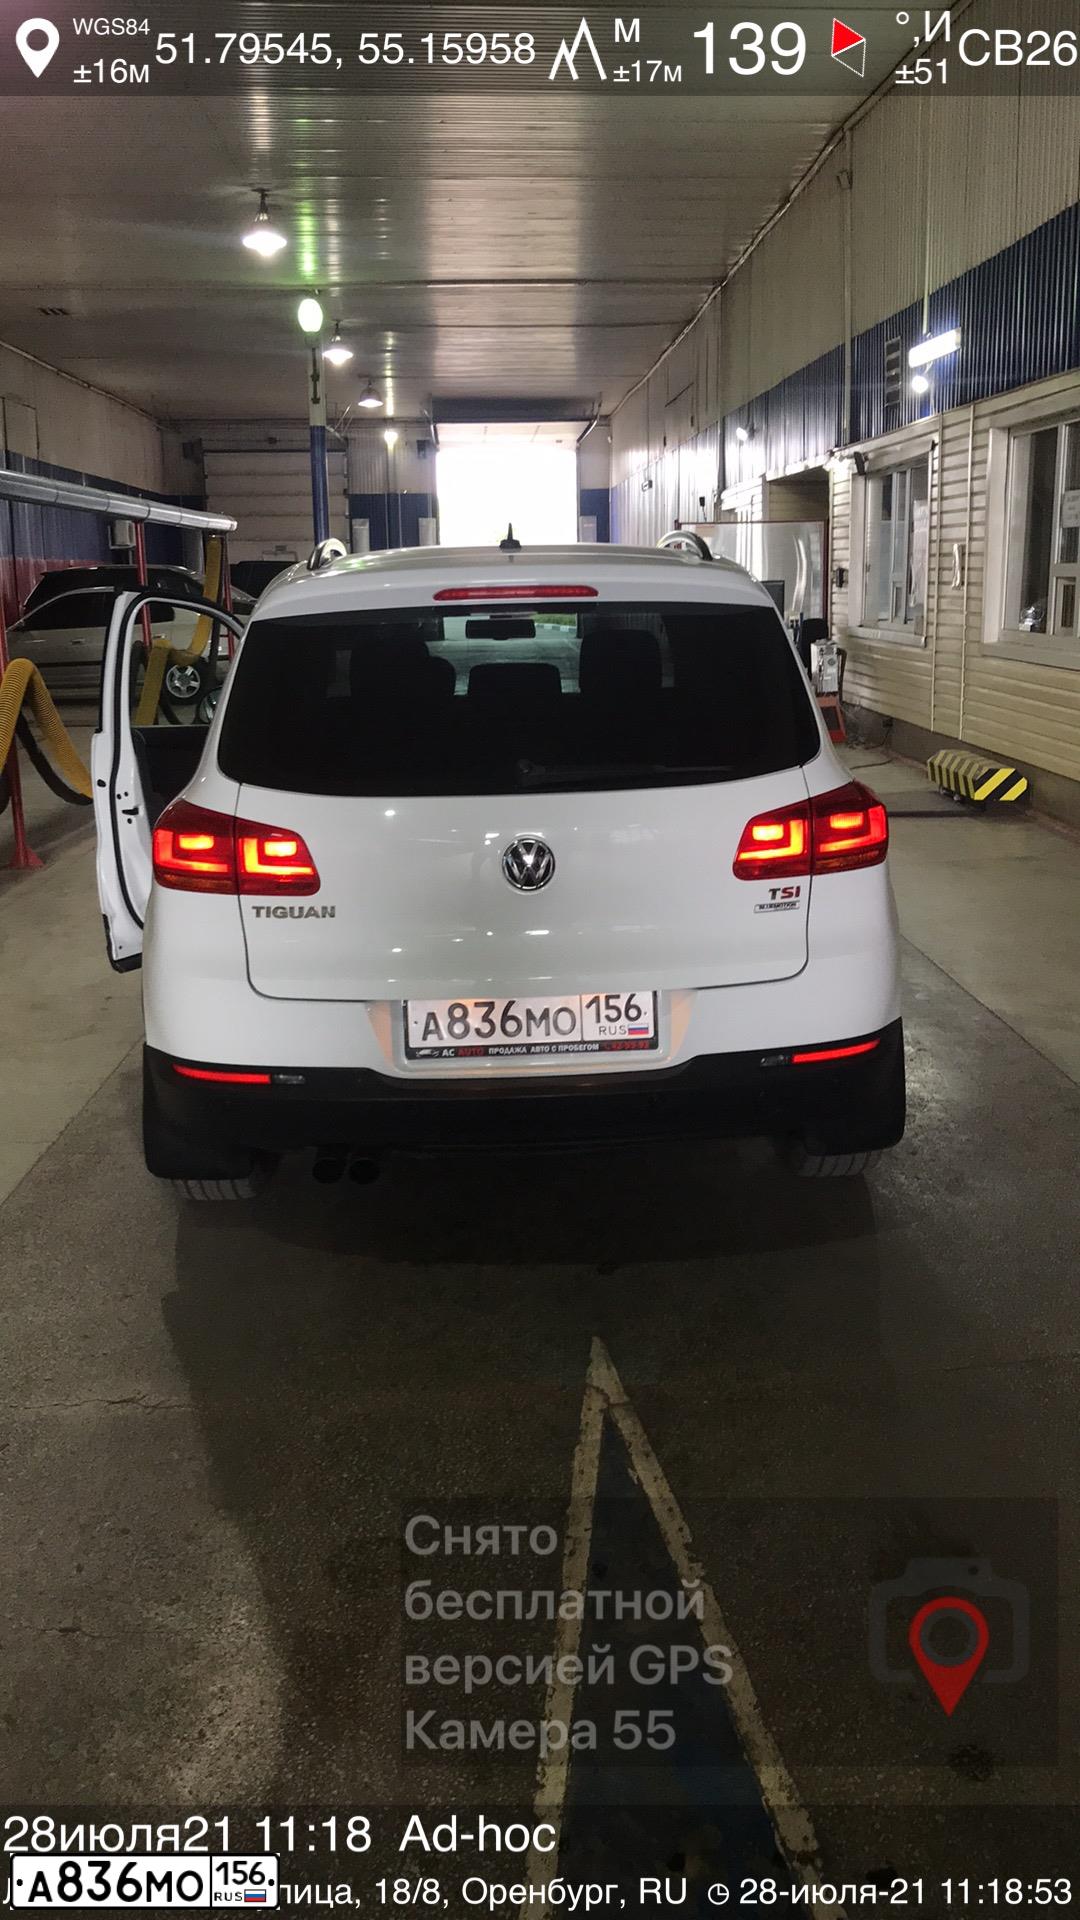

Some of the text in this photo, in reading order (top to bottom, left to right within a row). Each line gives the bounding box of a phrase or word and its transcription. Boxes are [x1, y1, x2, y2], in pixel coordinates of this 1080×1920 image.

[768, 886, 801, 901] TSI
[252, 906, 336, 919] TIGUAN
[585, 993, 642, 1023] 156
[599, 1025, 627, 1036] RUS
